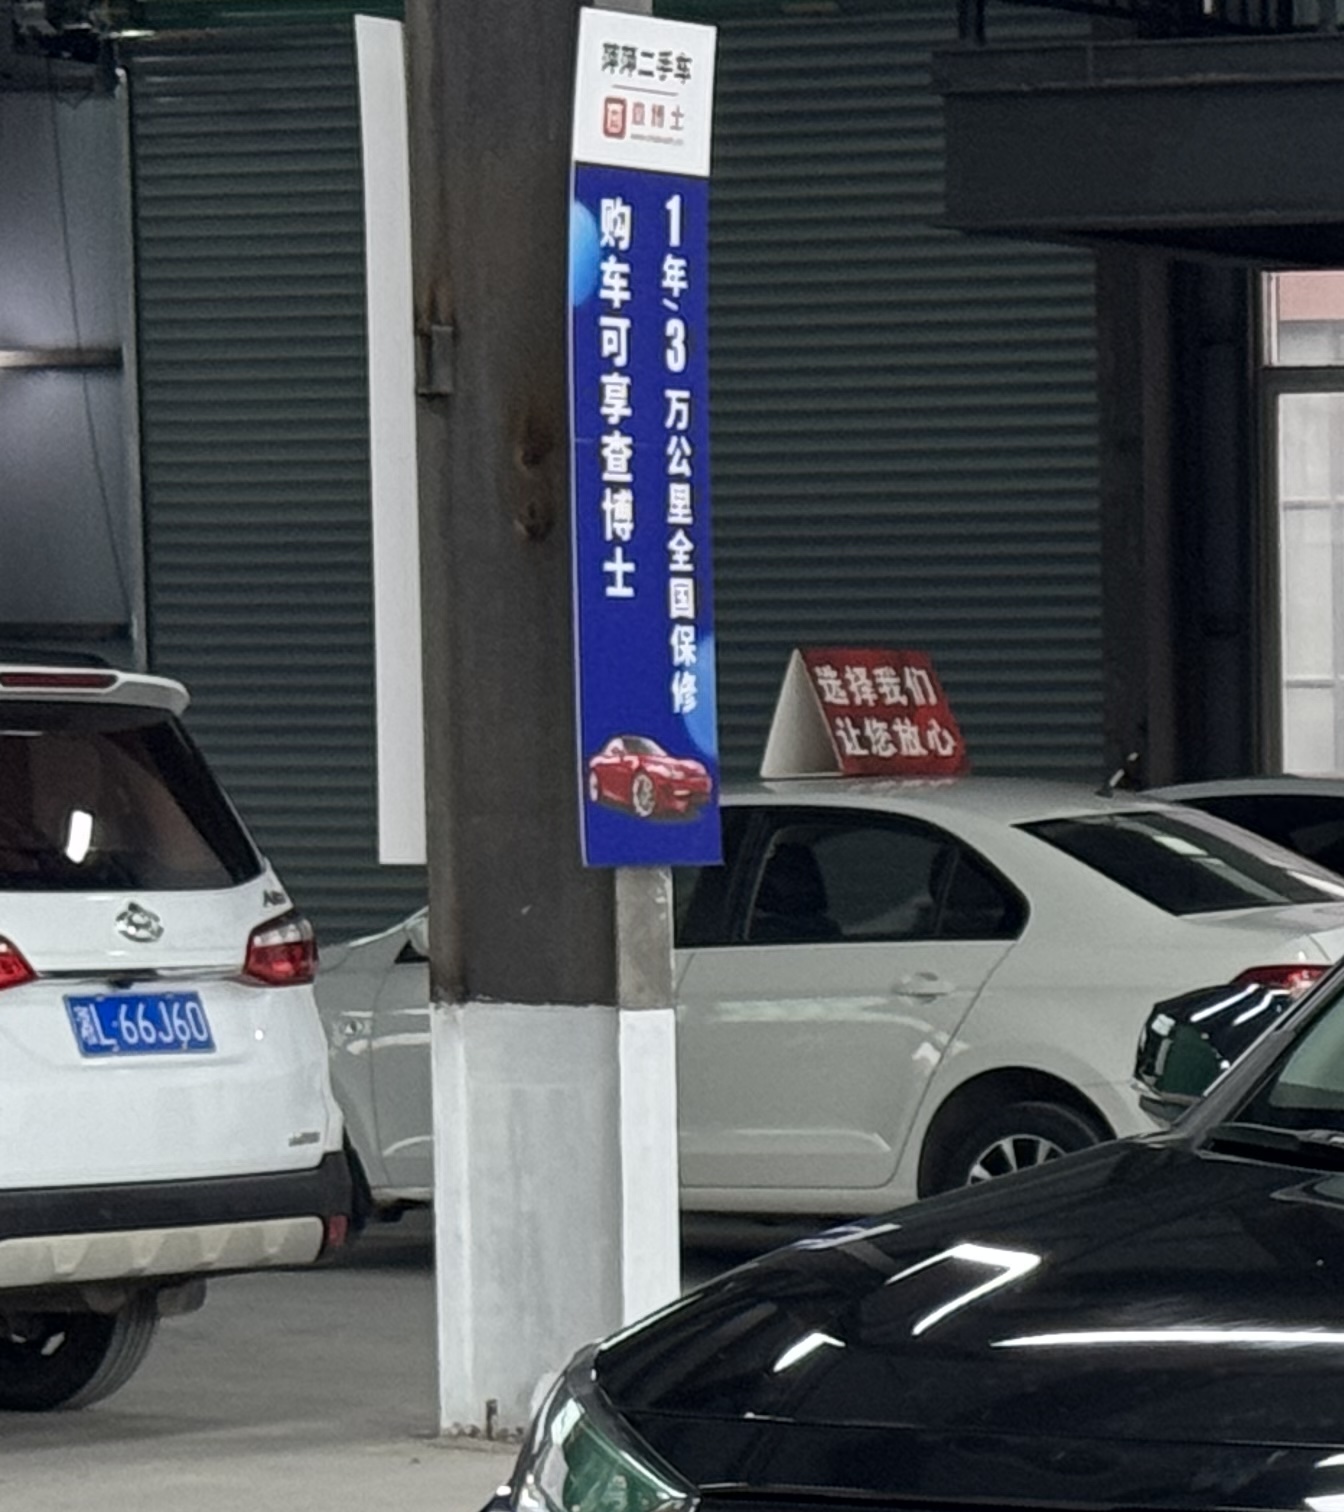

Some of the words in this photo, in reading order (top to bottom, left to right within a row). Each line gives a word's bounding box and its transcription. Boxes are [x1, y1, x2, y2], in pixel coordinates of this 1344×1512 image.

[598, 197, 636, 599] 购车可享查博士
[813, 664, 938, 707] 选择我们
[834, 715, 957, 758] 让您放心
